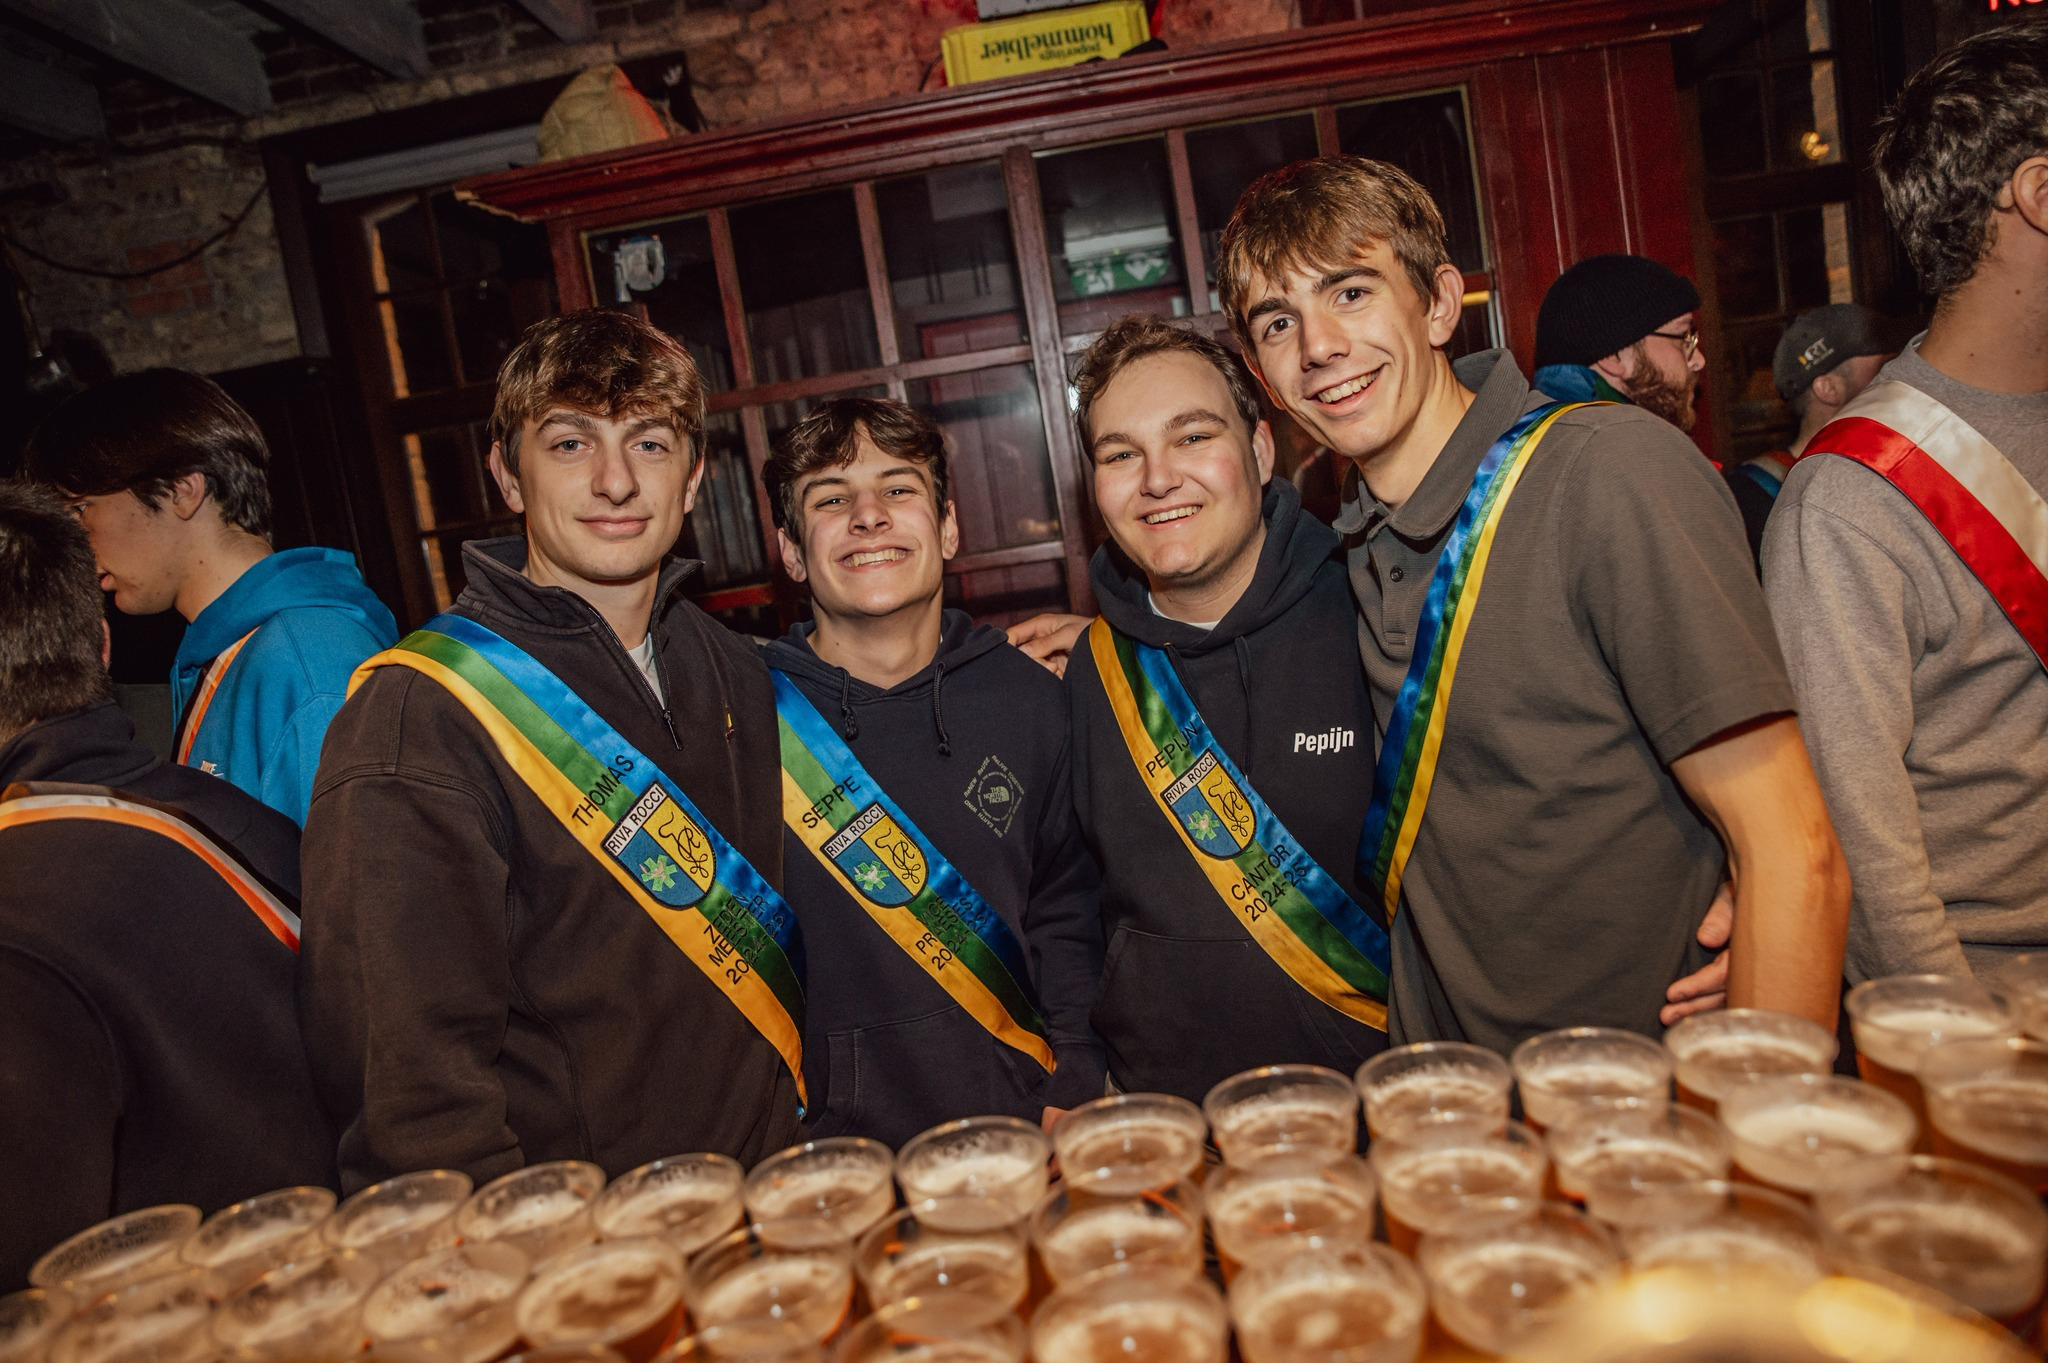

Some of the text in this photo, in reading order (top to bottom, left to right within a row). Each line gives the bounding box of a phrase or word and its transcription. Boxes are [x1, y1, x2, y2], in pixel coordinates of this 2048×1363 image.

[981, 23, 1114, 62] hommelbier
[1145, 721, 1198, 779] PEPIJN
[1293, 726, 1355, 756] Pepijn
[572, 754, 634, 827] THOMAS
[802, 776, 861, 829] SEPPE
[1166, 754, 1216, 804] RIVA ROCCI
[607, 785, 665, 854] RIVA ROCCI
[826, 806, 884, 857] RIVA ROCCI
[1231, 844, 1291, 901] CANTOR
[1244, 864, 1308, 922] 2024-25
[708, 894, 770, 967] MEESTER
[726, 914, 786, 985] 2024-25
[915, 896, 974, 955] PRAESES
[931, 912, 989, 970] 2024-25
